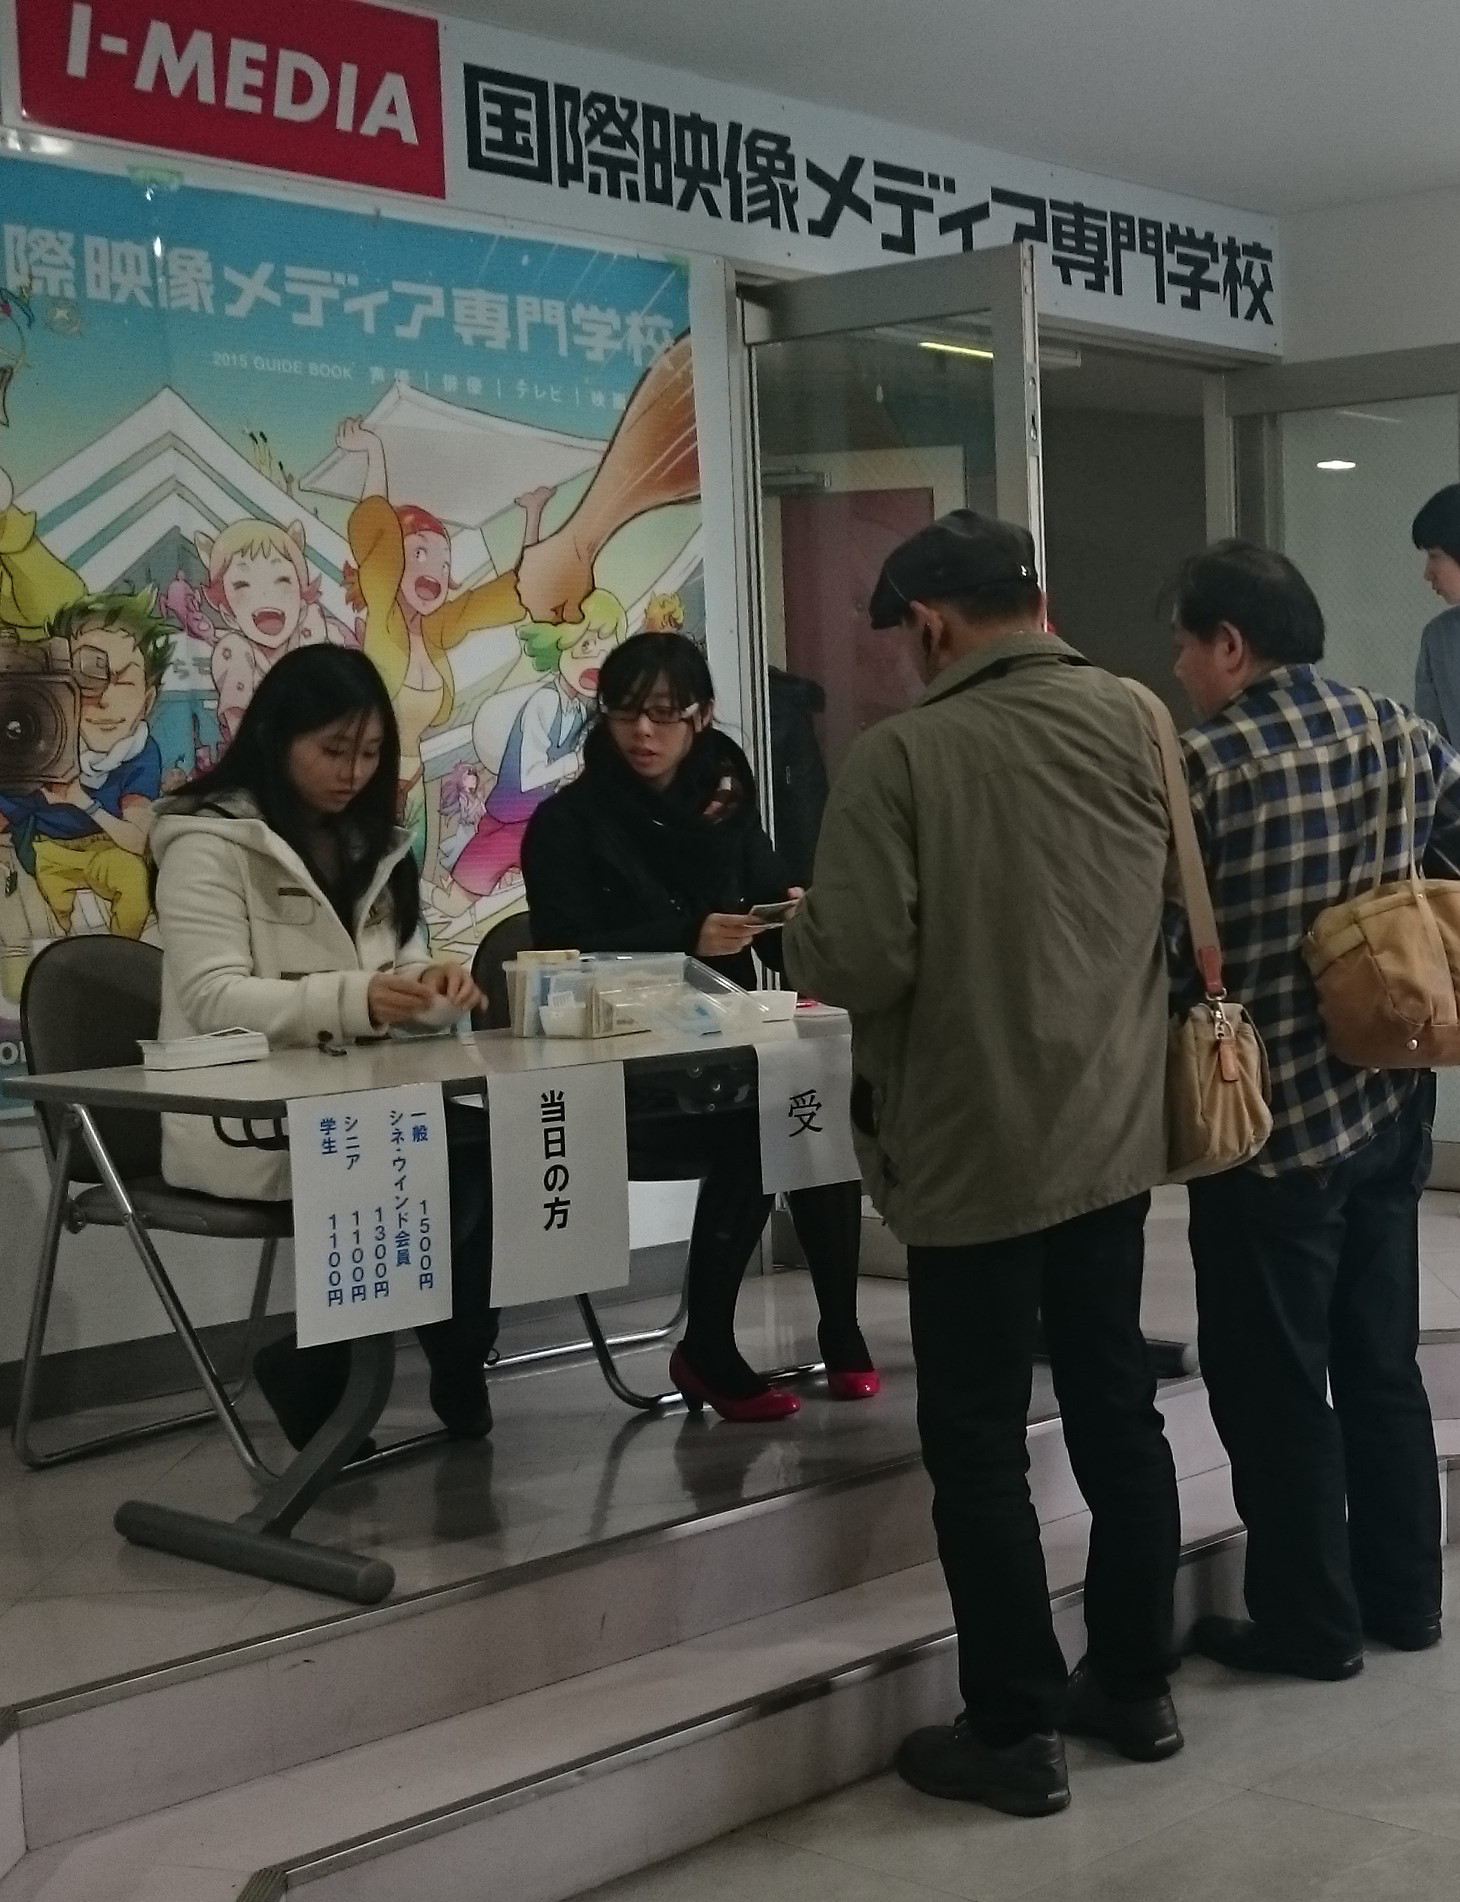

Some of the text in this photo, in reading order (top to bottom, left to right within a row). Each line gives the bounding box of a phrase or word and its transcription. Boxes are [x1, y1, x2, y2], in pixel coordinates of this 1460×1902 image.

[67, 2, 420, 146] I-MEDIA
[463, 63, 1275, 327] 国際映像メディア専門学校
[213, 352, 351, 380] 2015 GUIDE BOOK
[540, 1089, 571, 1232] 当日の方
[787, 1088, 823, 1138] 受
[319, 1117, 343, 1308] 学生 1100円
[344, 1115, 367, 1304] シニア 1100円
[374, 1206, 390, 1299] 1300円
[411, 1111, 434, 1291] 一般 1500円
